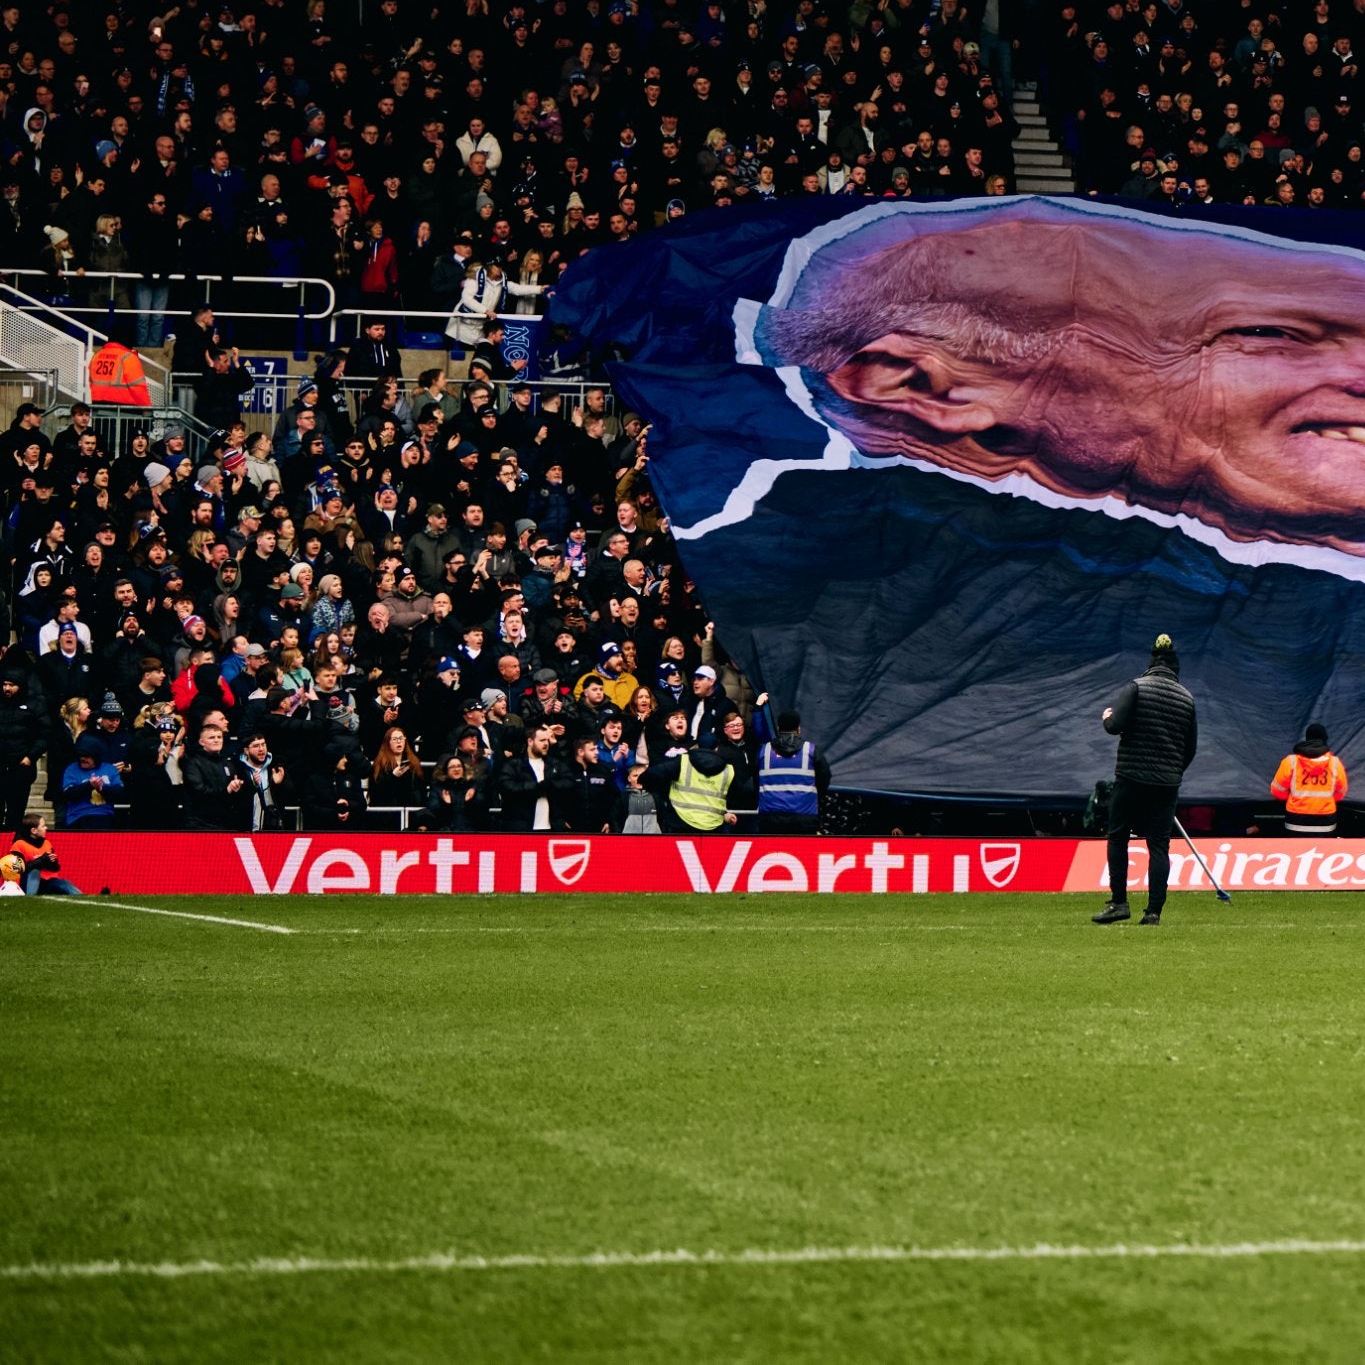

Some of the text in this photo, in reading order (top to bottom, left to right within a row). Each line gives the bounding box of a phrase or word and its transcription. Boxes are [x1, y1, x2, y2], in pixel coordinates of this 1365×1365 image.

[96, 360, 115, 376] 252
[263, 361, 275, 382] 7
[262, 387, 273, 408] 6
[233, 837, 538, 894] Vertu
[676, 840, 969, 894] Vertu
